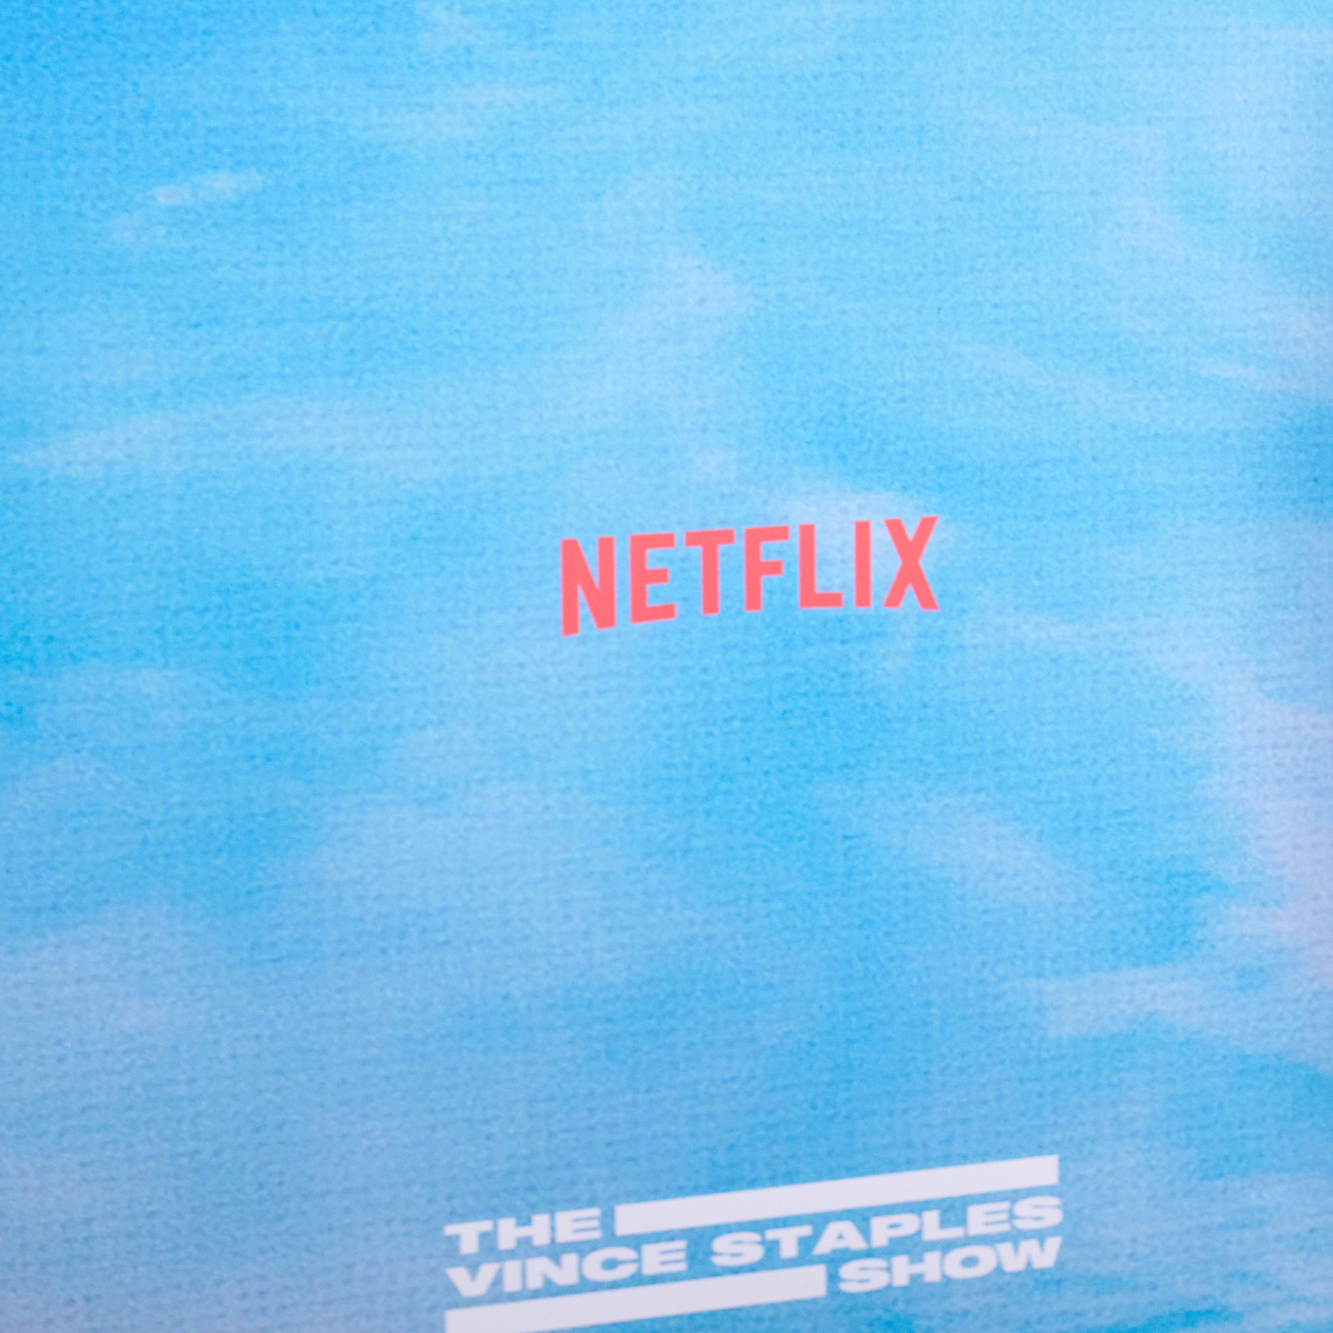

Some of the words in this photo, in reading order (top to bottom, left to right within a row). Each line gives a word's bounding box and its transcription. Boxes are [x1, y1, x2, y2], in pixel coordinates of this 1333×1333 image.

[561, 516, 938, 636] NETFLIX
[443, 1206, 603, 1256] THE
[444, 1242, 688, 1299] VINCE
[710, 1194, 1065, 1267] STAPLES
[838, 1235, 1064, 1293] SHOW
